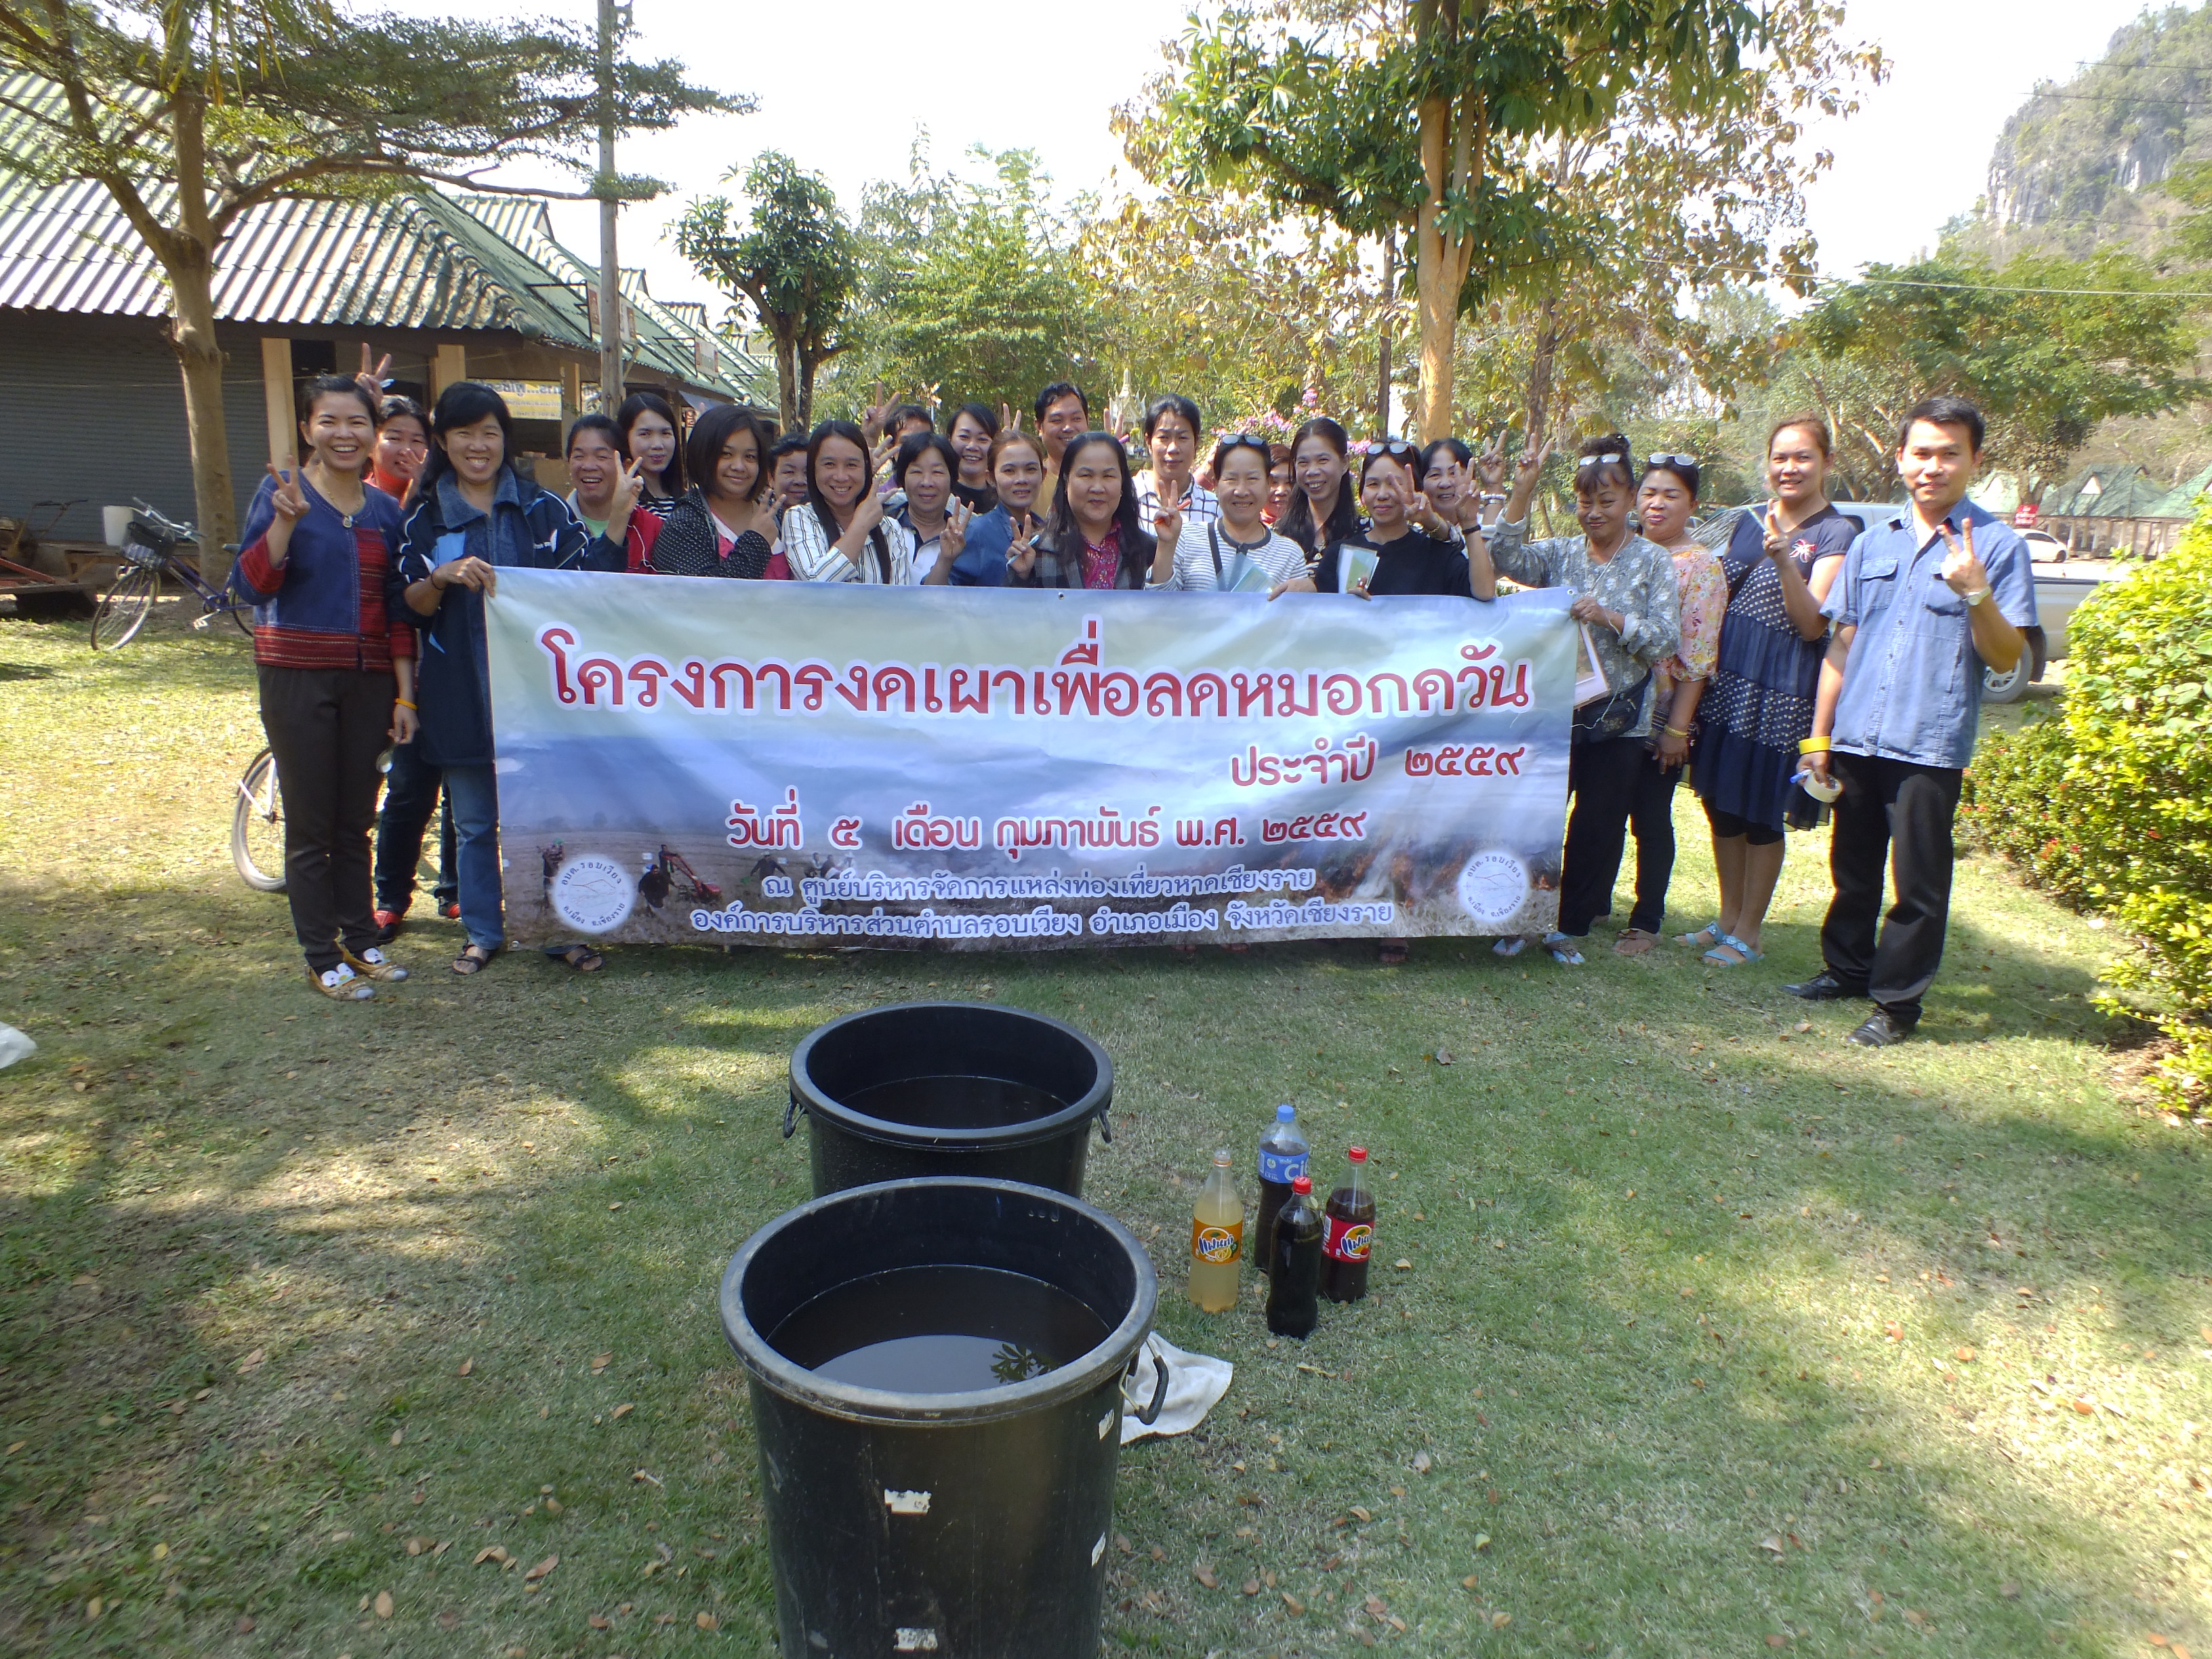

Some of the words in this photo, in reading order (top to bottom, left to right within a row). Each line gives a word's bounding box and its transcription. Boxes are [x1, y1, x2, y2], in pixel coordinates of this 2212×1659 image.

[541, 621, 1528, 717] โครงการงดเผาเพื่อลดหมอกควัน
[1232, 735, 1376, 786] ประจำปี
[1405, 746, 1525, 776] ๒๕๕๙
[729, 788, 800, 846] วันที่
[832, 819, 859, 846] ๕
[895, 804, 978, 846] เดือน
[997, 806, 1161, 859] กุมภาพันธ์
[1176, 817, 1245, 846] พ.ศ.
[1262, 811, 1367, 841] ๒๕๕๙
[765, 879, 790, 894] ณ
[693, 904, 1079, 935] องค์การบริหารส่วนตำบลรอบเวียง
[1092, 905, 1216, 931] อำเภอเมือง
[1227, 899, 1392, 926] จังหวัดเชียงราย
